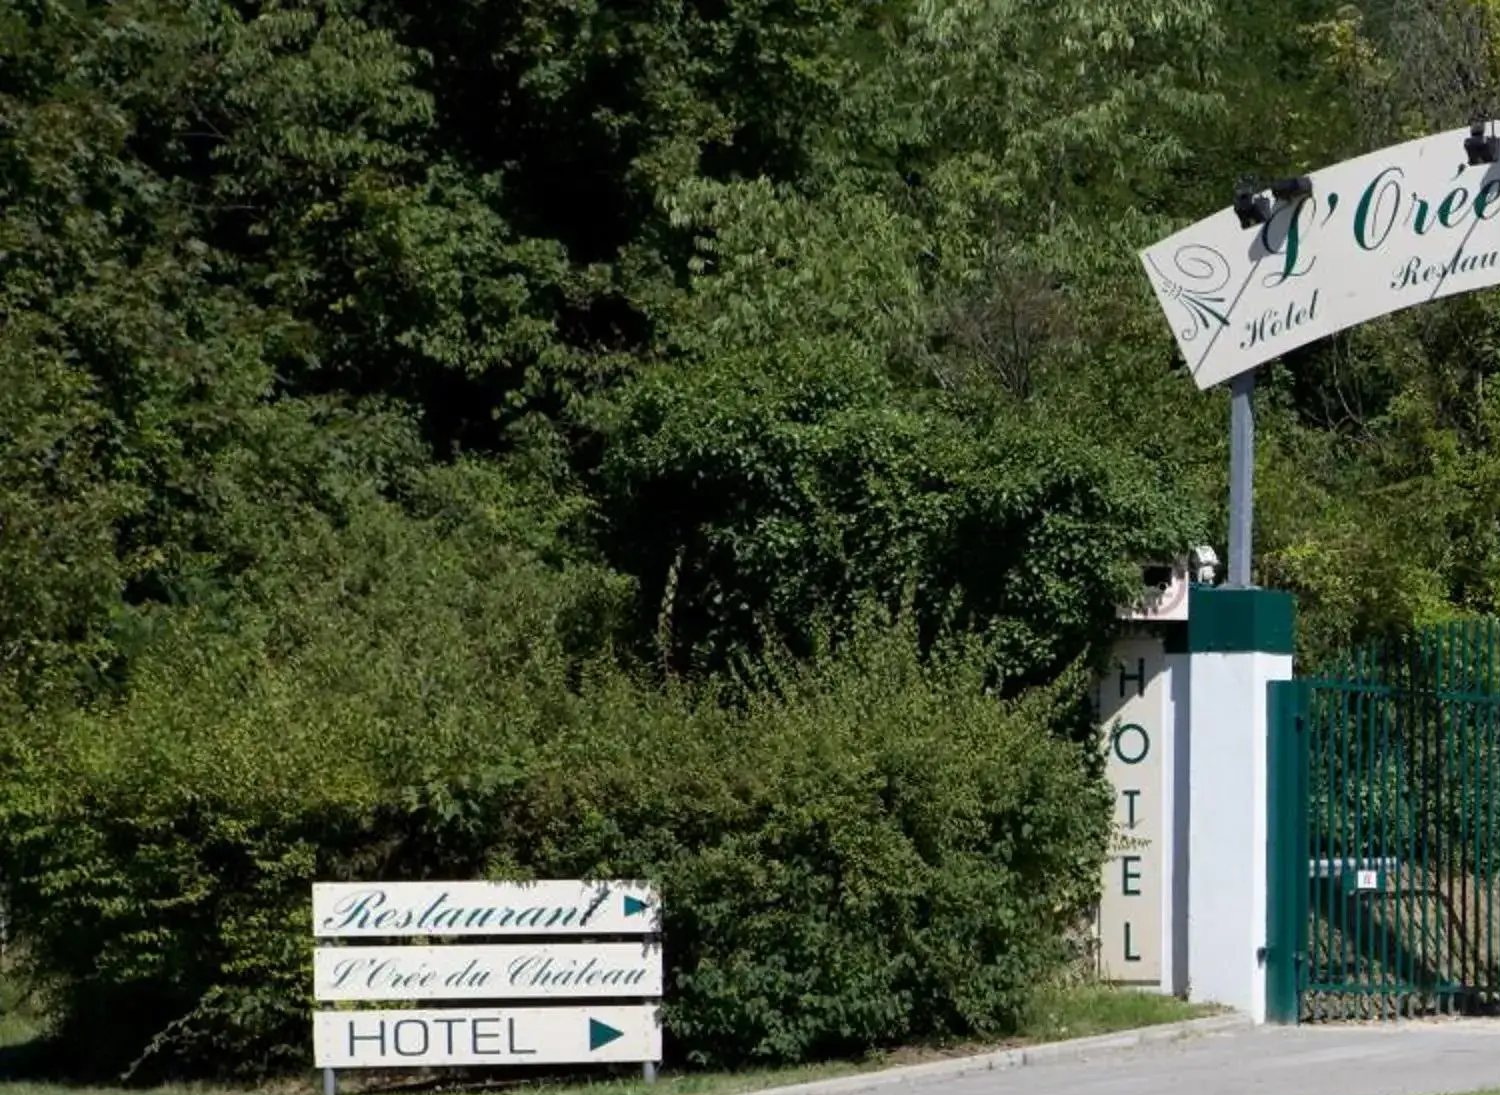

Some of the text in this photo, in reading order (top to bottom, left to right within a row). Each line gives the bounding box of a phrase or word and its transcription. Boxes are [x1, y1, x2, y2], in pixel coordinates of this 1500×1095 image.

[1240, 288, 1319, 349] Hôtel
[1114, 657, 1150, 962] HOTEL
[323, 885, 610, 930] Restaurant
[331, 955, 648, 989] L'Orée du Château
[348, 1017, 538, 1058] HOTEL
